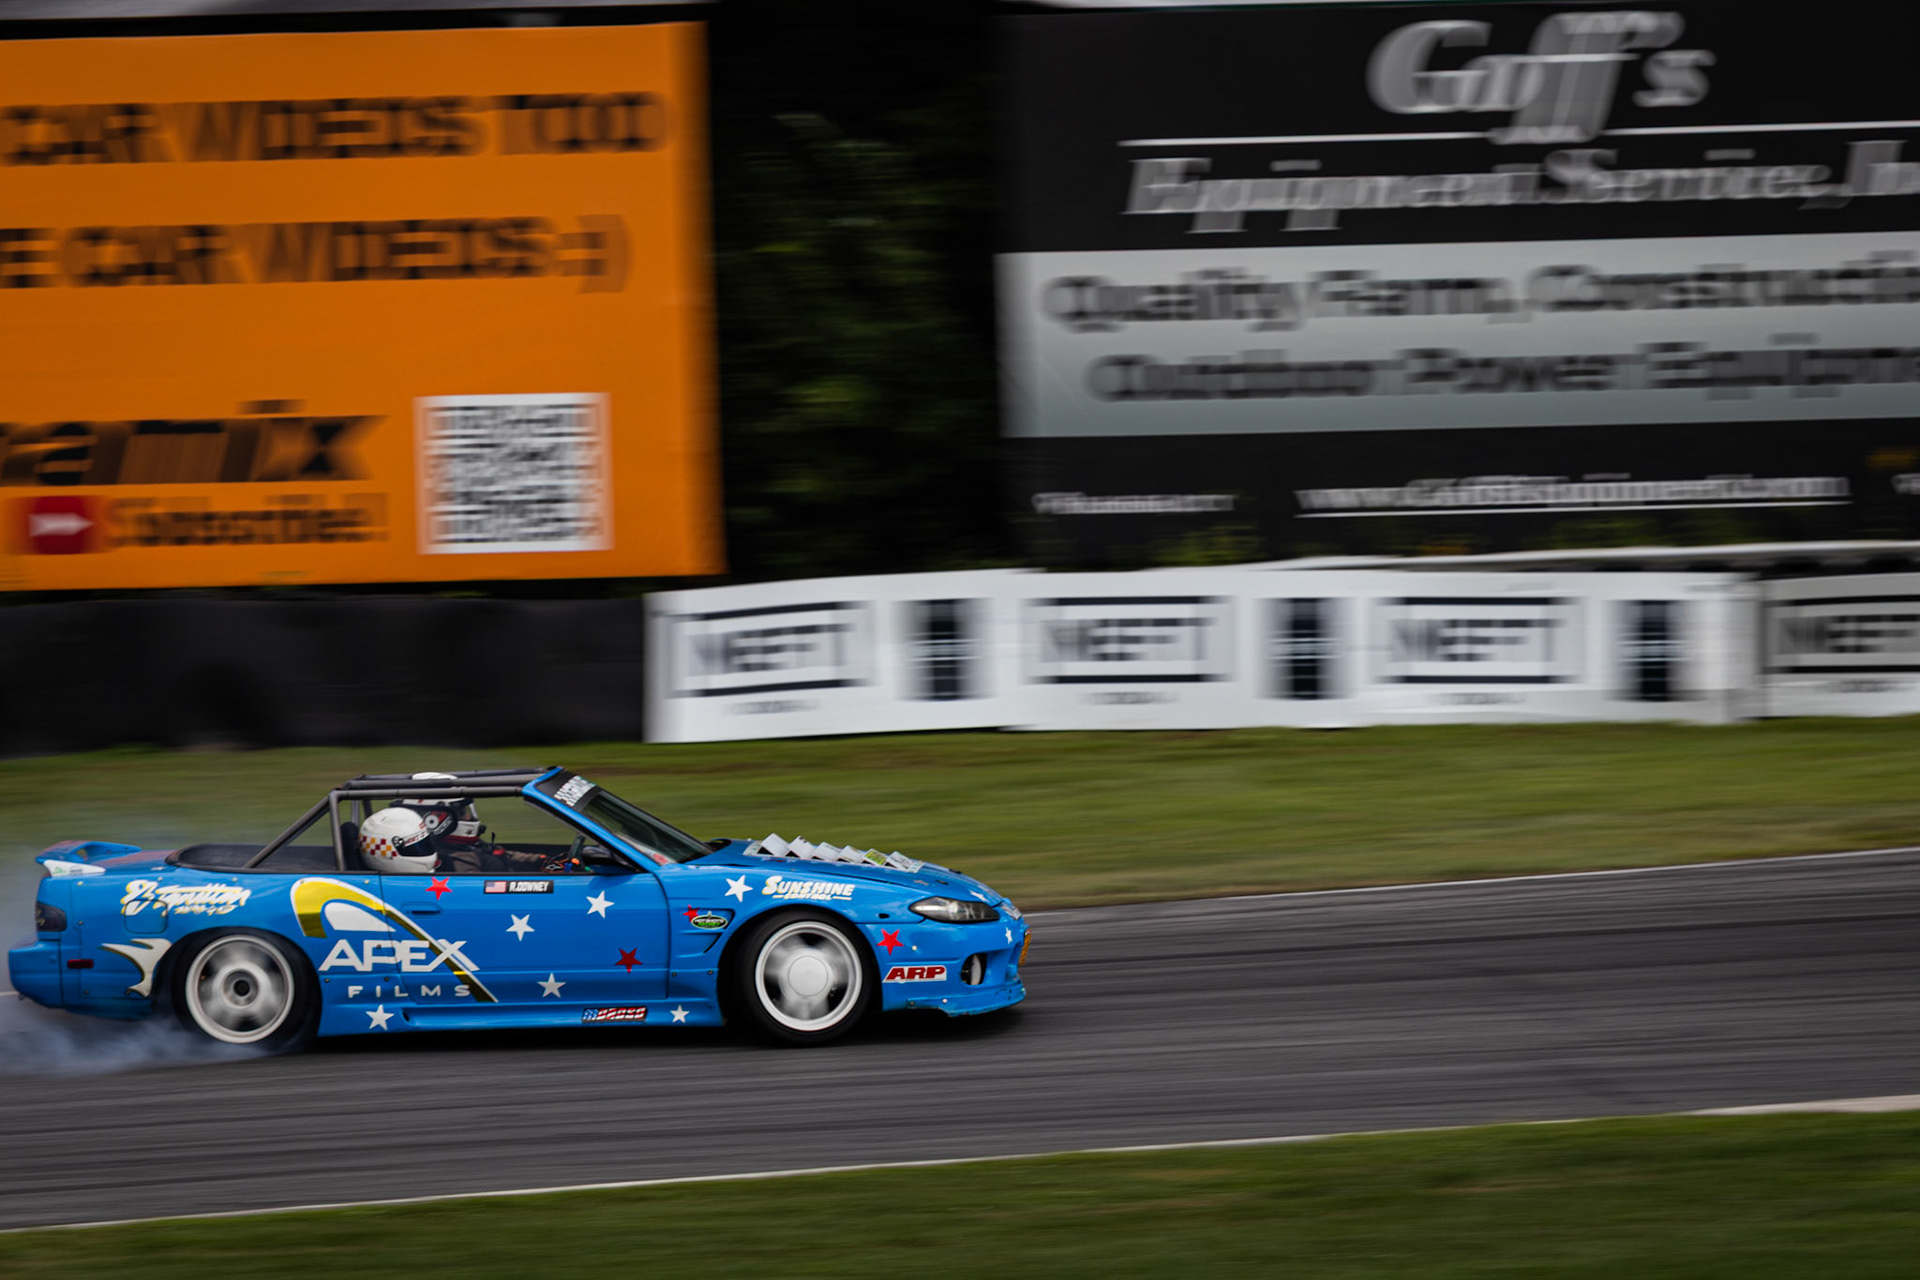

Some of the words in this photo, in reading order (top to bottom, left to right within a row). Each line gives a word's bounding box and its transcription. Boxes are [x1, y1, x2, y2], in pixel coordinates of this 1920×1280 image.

[1122, 157, 1540, 233] Equipment
[1042, 267, 1303, 333] Quality
[762, 875, 856, 896] SUNSHINE
[318, 939, 480, 972] APEX
[886, 966, 946, 980] ARP
[348, 984, 471, 999] FILMS
[583, 1007, 647, 1021] MOROSO
